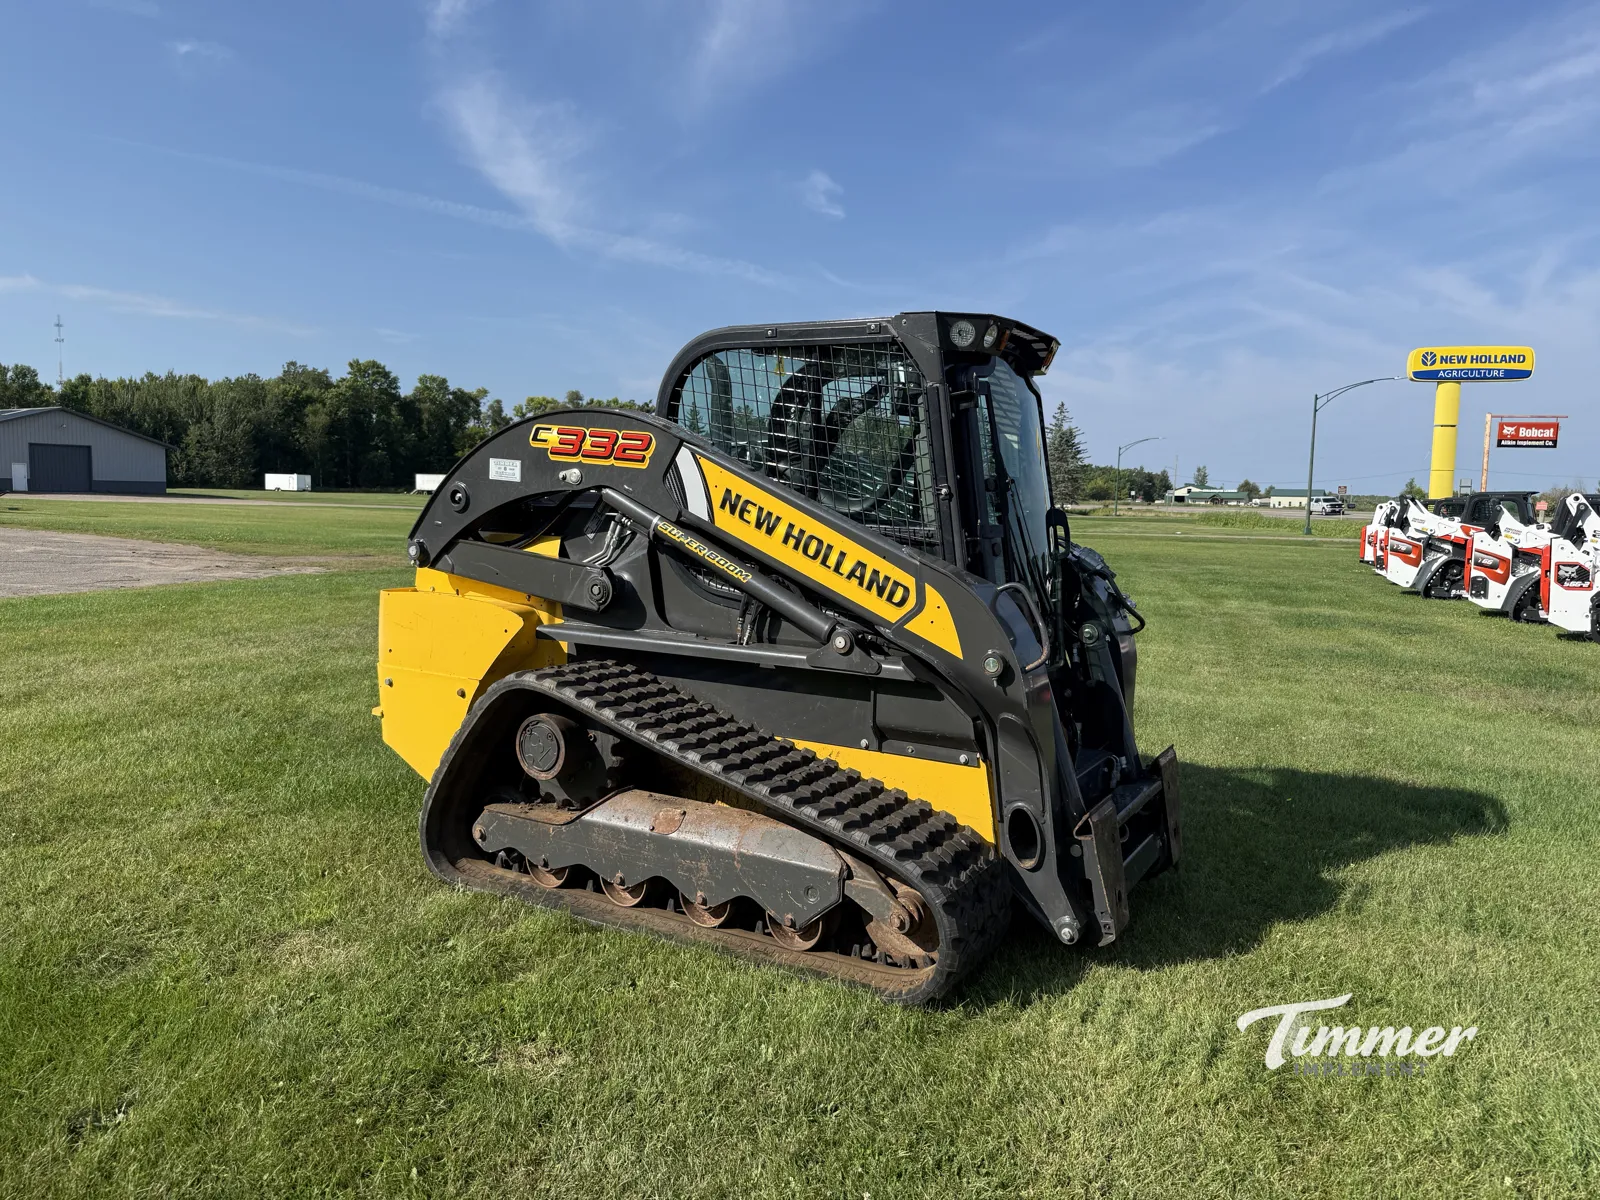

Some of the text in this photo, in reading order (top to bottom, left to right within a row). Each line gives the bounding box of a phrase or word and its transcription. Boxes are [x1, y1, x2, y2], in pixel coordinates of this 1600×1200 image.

[1439, 353, 1526, 365] NEW HOLLAND
[1437, 369, 1505, 378] AGRICULTURE
[1518, 426, 1555, 438] Bobcat
[657, 521, 753, 583] SUPER BOOM
[719, 487, 911, 609] NEW HOLLAND
